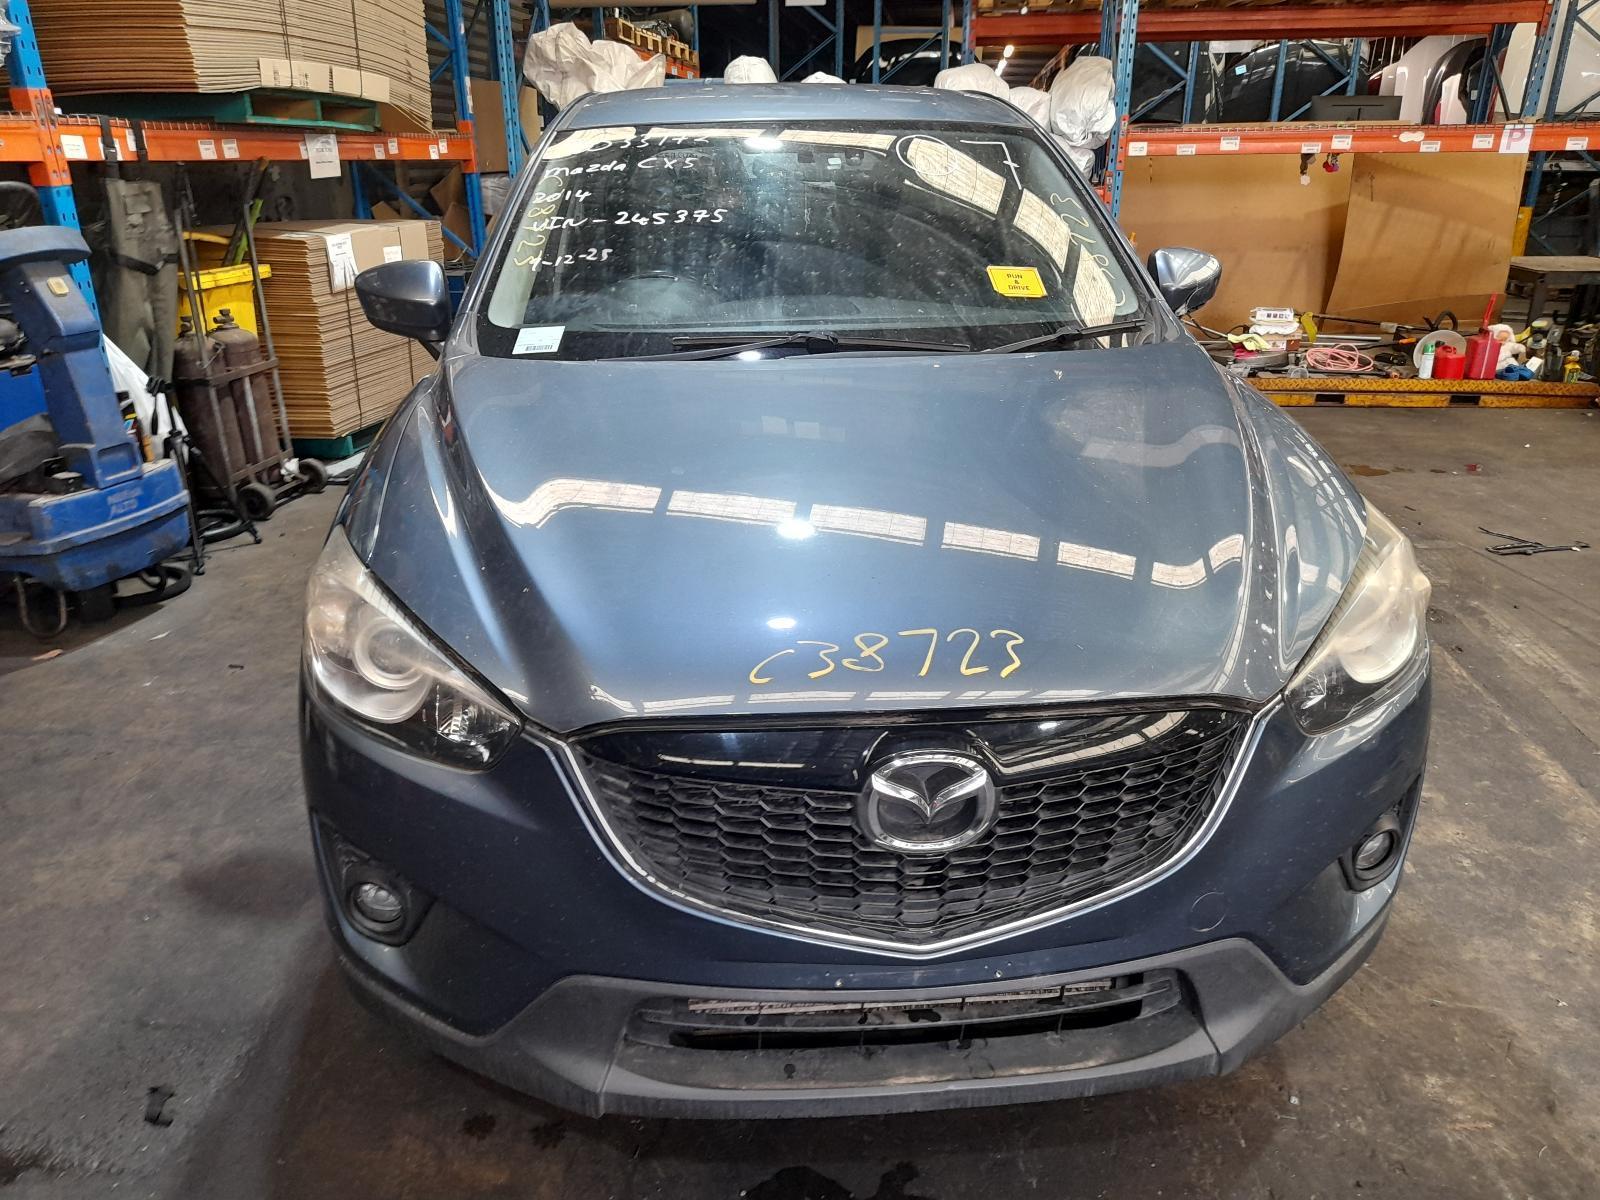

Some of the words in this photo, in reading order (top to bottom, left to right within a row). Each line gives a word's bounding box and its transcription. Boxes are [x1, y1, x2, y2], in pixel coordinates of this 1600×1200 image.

[1505, 128, 1526, 151] P
[533, 189, 592, 202] 2014
[749, 628, 1024, 684] C38723
